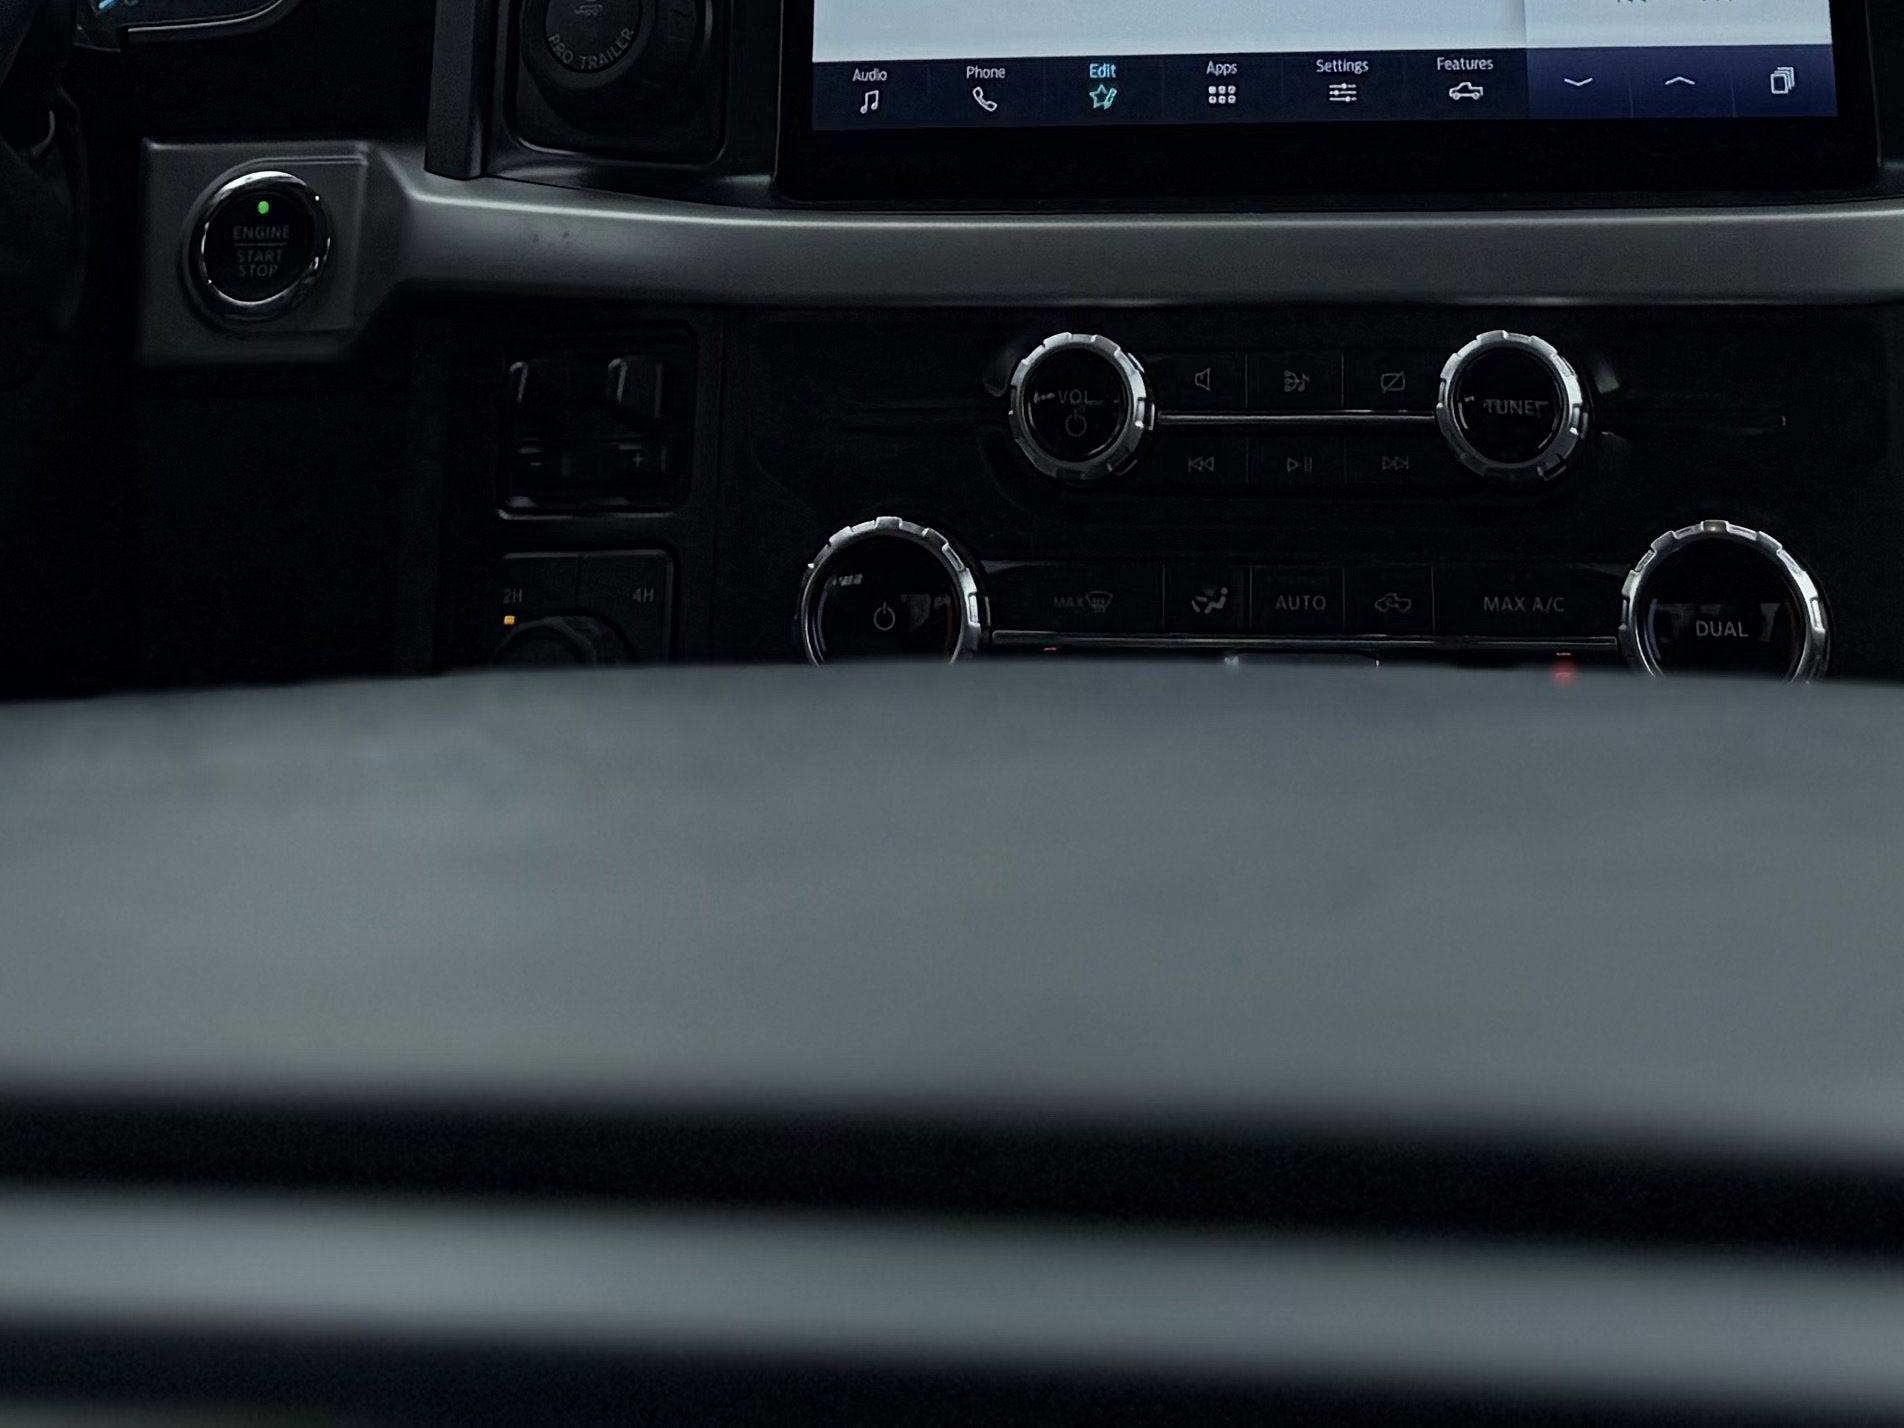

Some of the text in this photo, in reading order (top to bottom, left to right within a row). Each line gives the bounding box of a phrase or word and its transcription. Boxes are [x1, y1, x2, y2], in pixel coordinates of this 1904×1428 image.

[547, 27, 635, 70] PRO TRAILER
[1088, 63, 1117, 79] Edit
[1205, 60, 1238, 77] Apps
[1315, 58, 1370, 75] Settings
[1436, 56, 1495, 72] Features
[852, 67, 889, 83] Audio
[965, 65, 1007, 80] Phone
[232, 224, 290, 239] ENGINE
[236, 248, 283, 262] START
[239, 264, 279, 277] STOP
[1057, 389, 1089, 404] VOL
[1274, 594, 1328, 612] AUTO
[1481, 595, 1566, 614] MAX A/C
[1695, 619, 1750, 638] DUAL
